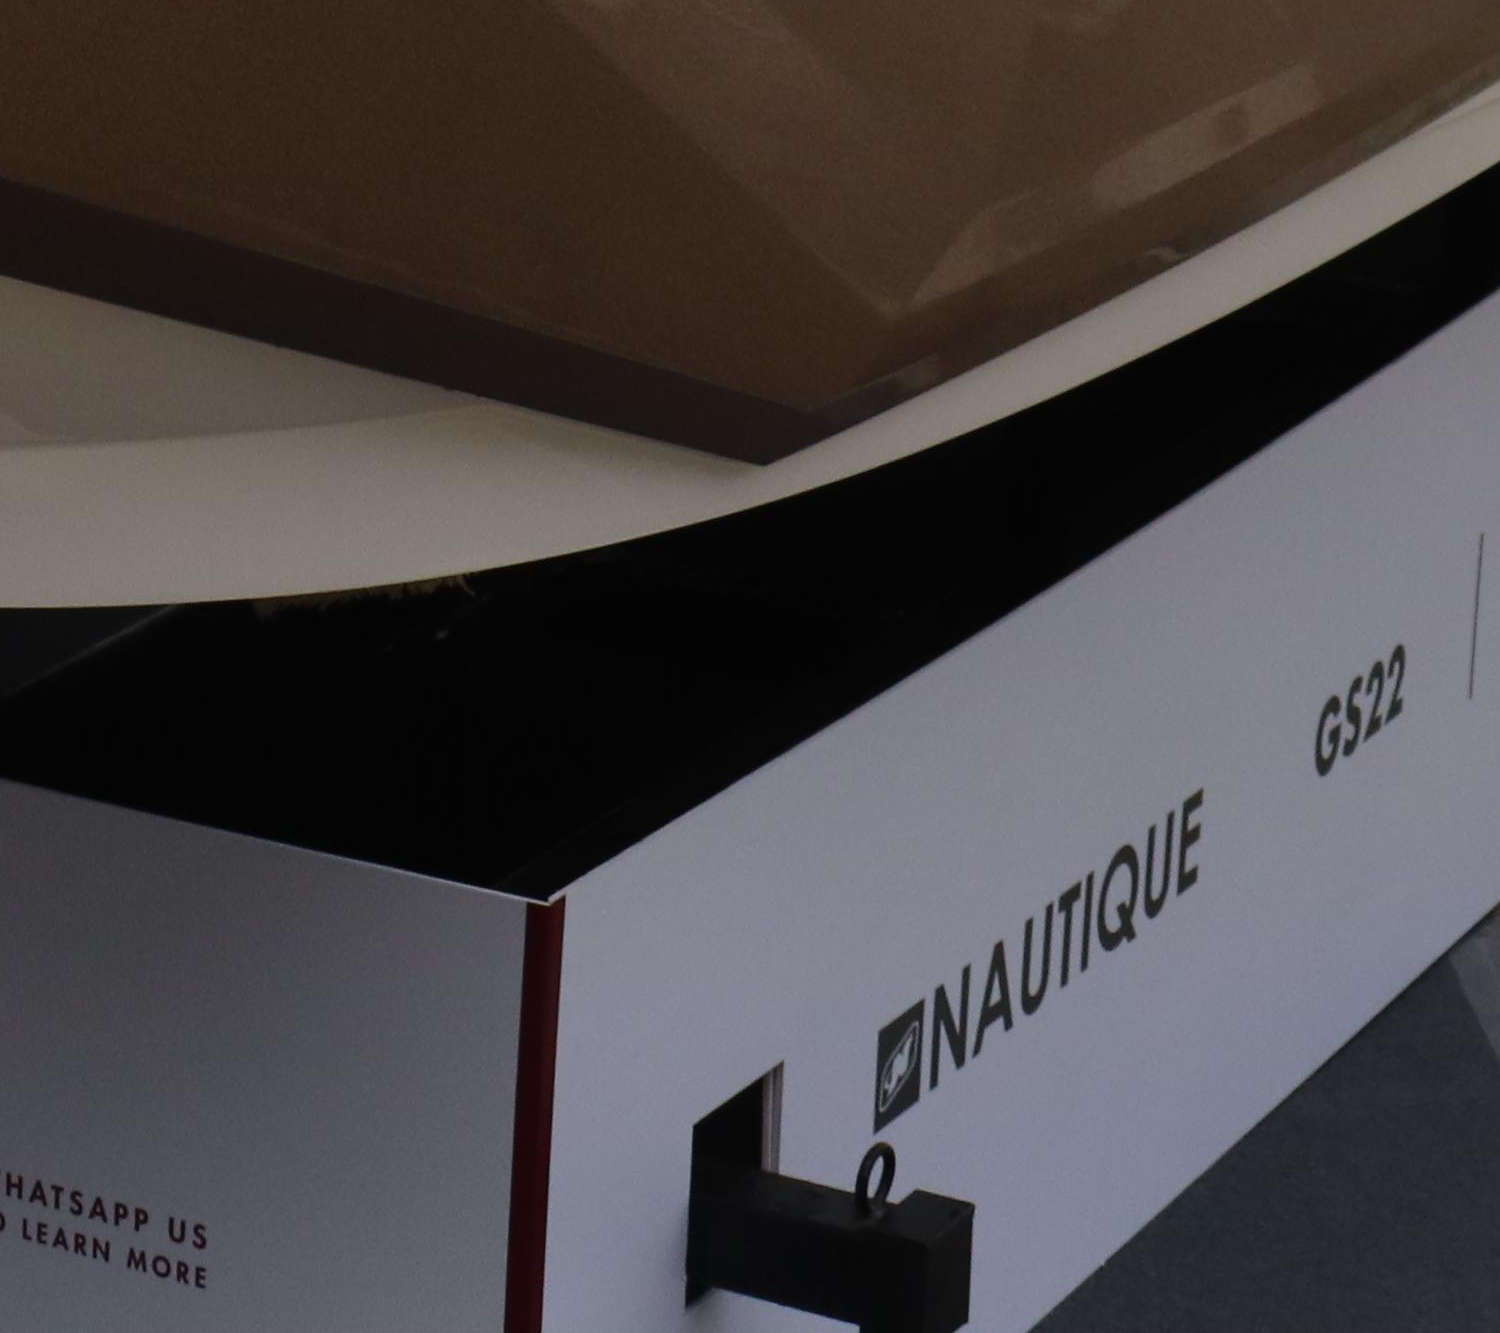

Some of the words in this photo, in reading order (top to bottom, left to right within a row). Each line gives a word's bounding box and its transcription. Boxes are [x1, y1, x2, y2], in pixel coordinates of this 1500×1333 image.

[929, 787, 1205, 1092] NAUTIQUE
[1314, 643, 1406, 777] GS22
[21, 1218, 111, 1263] LEARN
[126, 1247, 207, 1289] MORE
[168, 1216, 208, 1250] US
